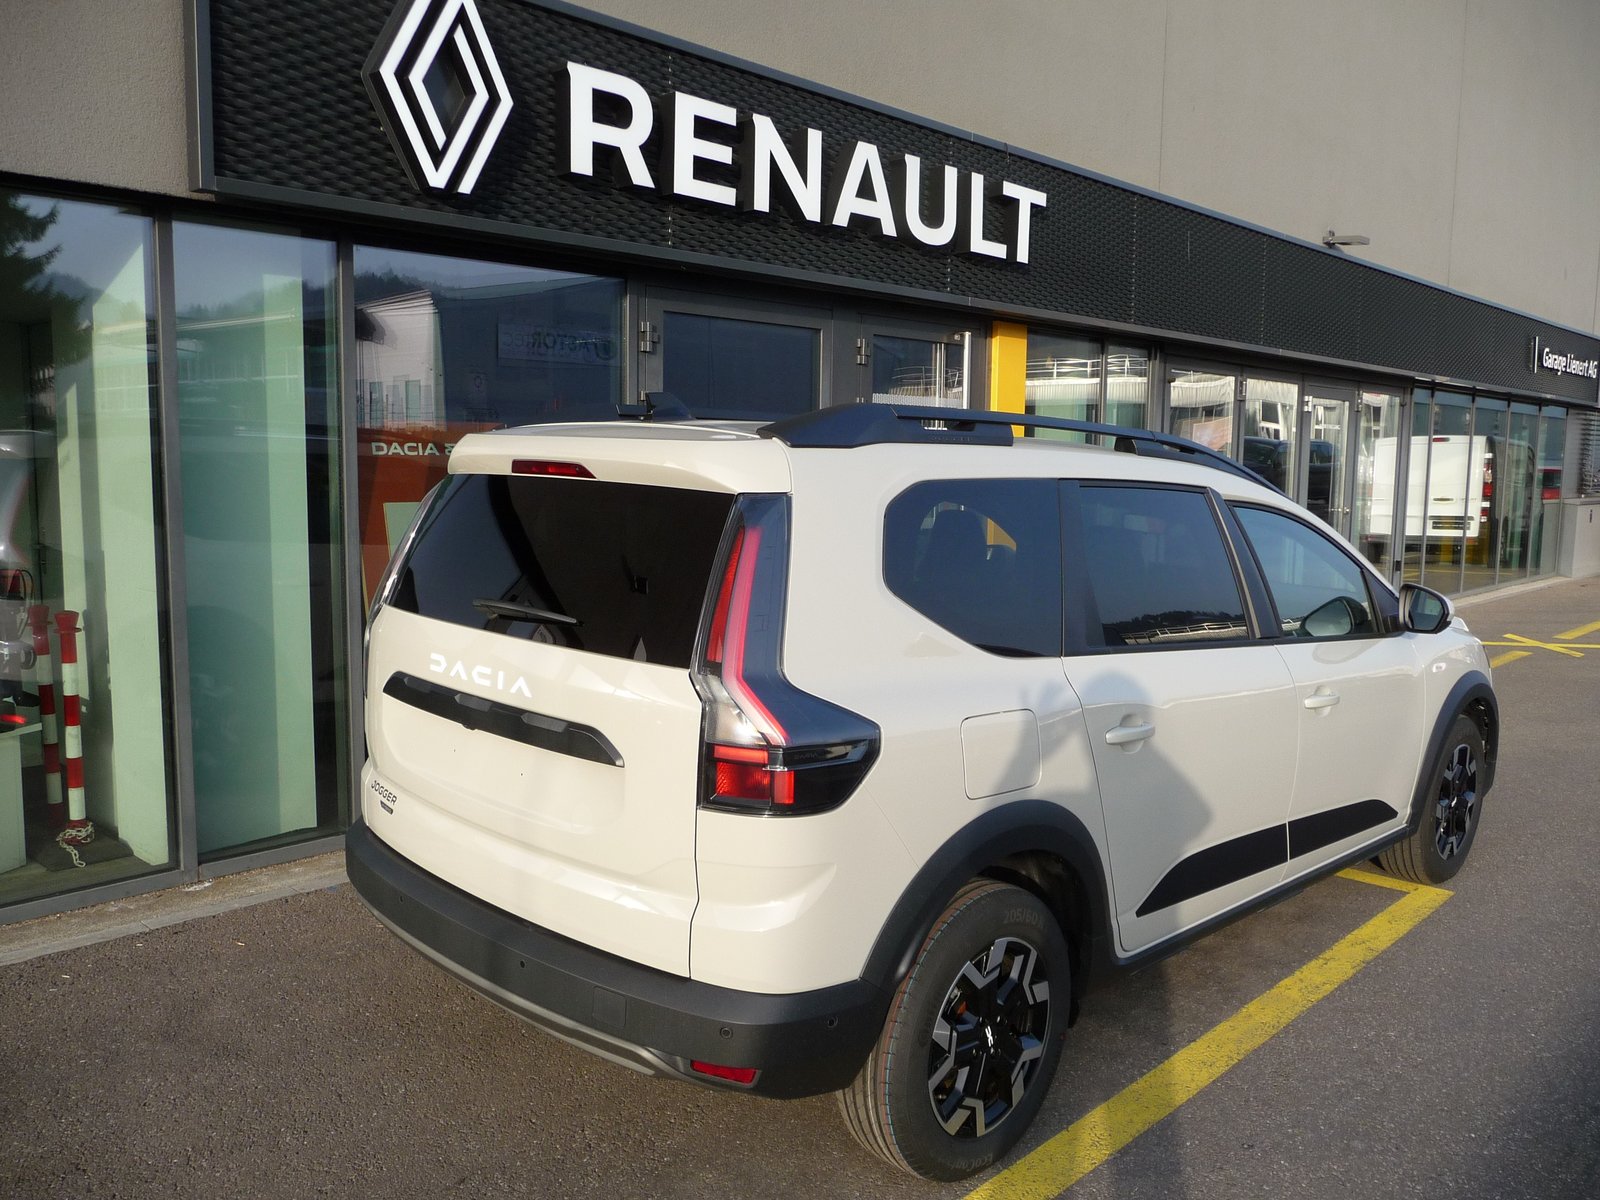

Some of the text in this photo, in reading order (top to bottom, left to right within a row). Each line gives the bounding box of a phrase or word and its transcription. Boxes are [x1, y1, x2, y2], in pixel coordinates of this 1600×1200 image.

[566, 61, 1047, 263] RENAULT
[1543, 347, 1598, 378] Garage Lienert AG
[371, 442, 440, 456] DACIA
[428, 652, 533, 698] DACIA
[371, 779, 398, 806] JOGGER
